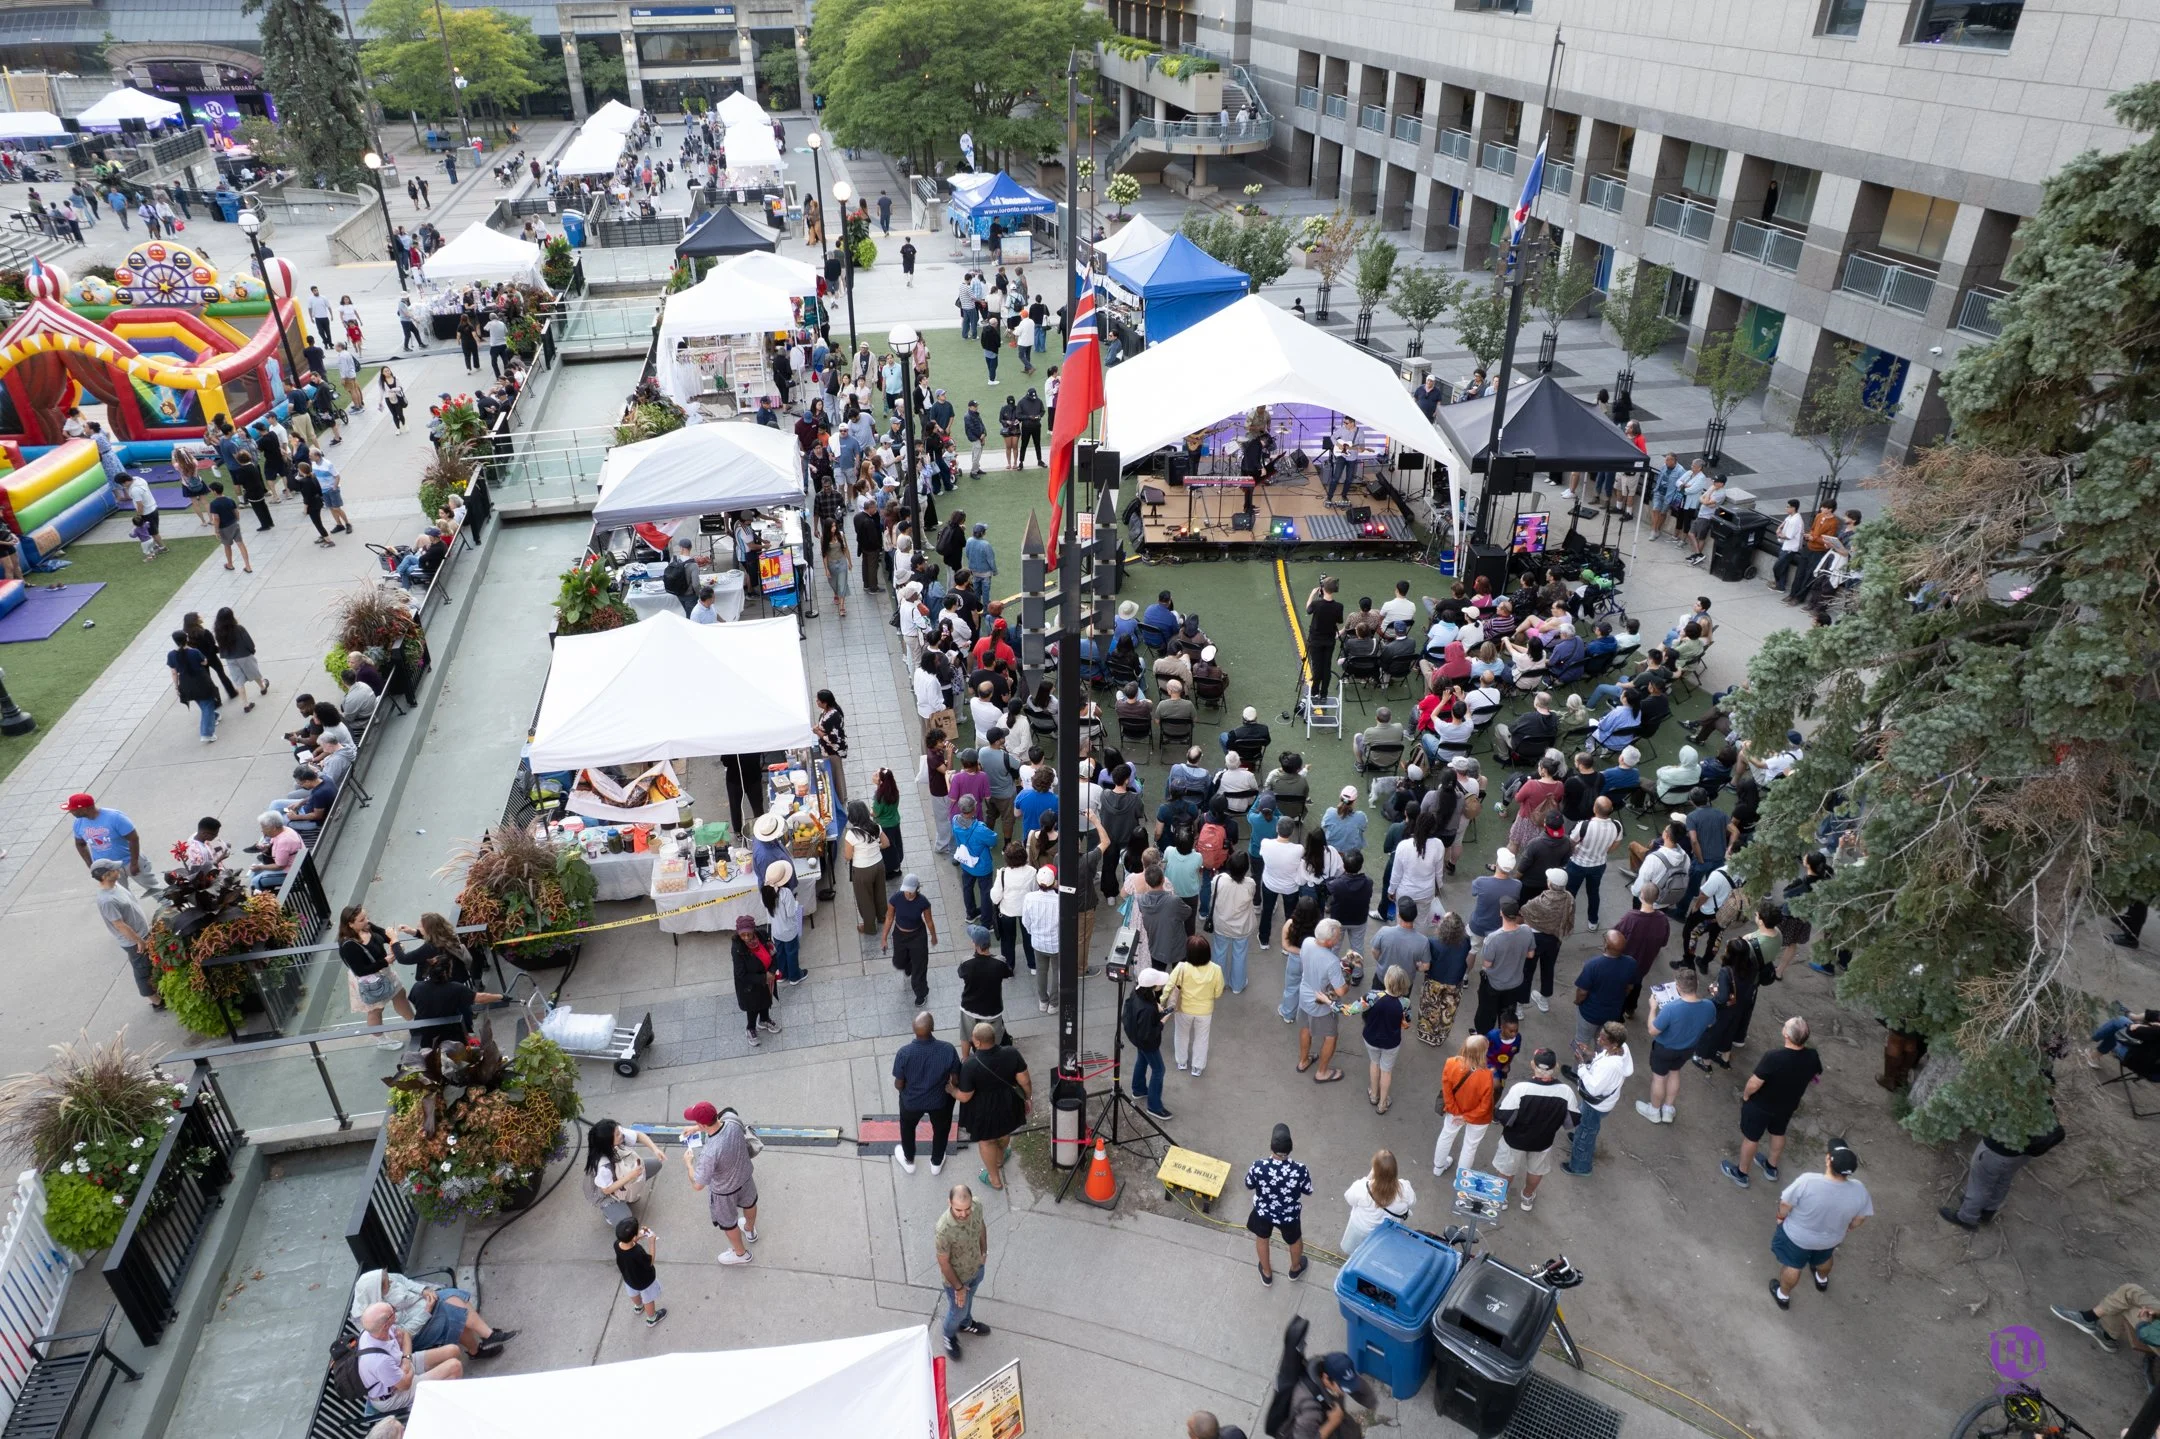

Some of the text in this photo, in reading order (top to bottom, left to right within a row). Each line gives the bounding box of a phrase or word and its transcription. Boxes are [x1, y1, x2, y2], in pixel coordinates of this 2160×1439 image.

[984, 205, 1045, 215] www.toronto.ca/water
[611, 917, 643, 927] CAUTION
[649, 907, 681, 919] CAUTION
[686, 898, 717, 910] CAUTION
